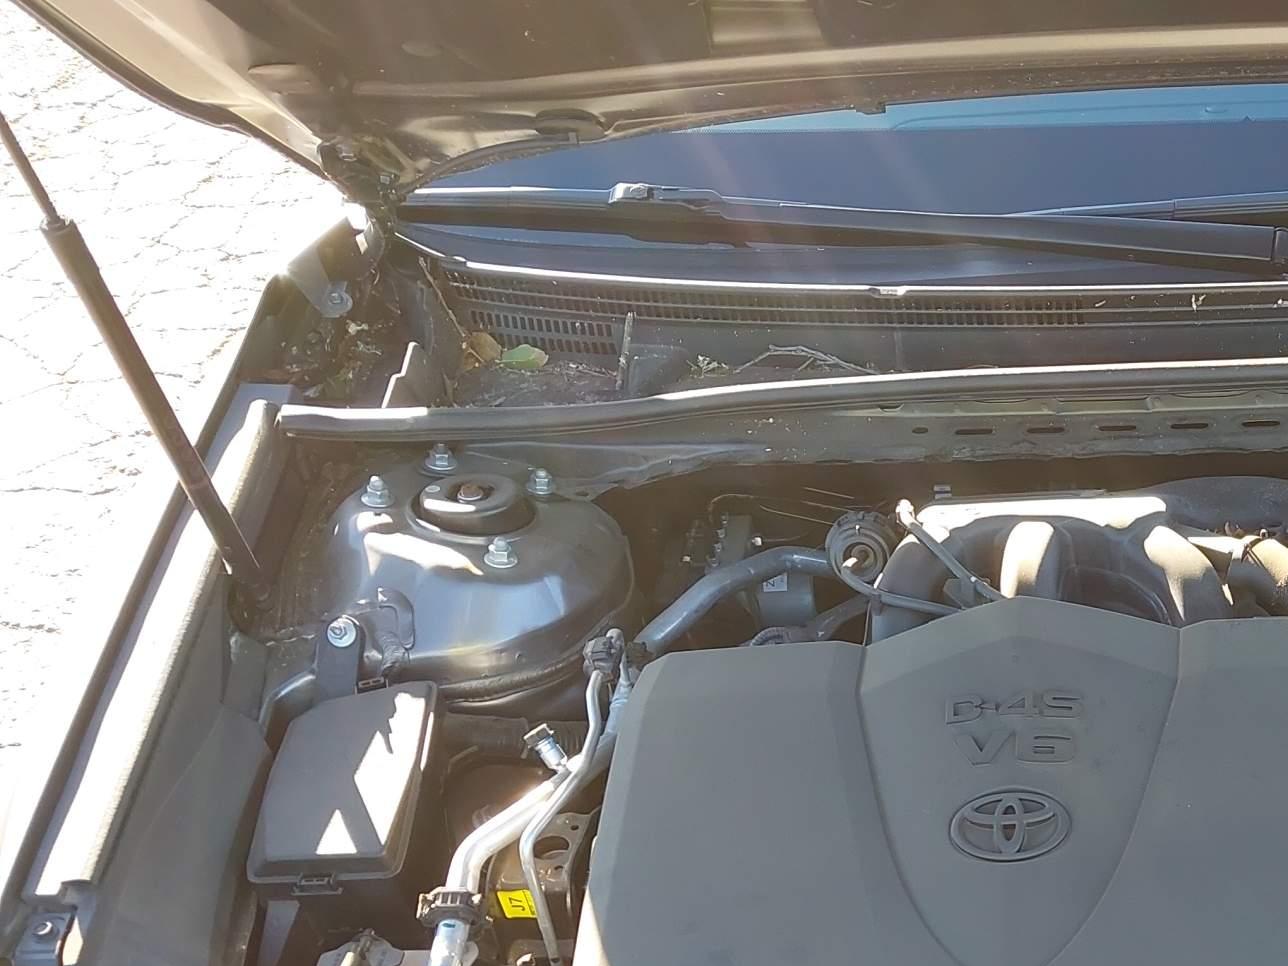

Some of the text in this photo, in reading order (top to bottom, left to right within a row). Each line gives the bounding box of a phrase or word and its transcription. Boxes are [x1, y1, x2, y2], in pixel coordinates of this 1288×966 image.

[945, 689, 1084, 725] D-4S
[953, 729, 1079, 766] V6
[508, 897, 526, 911] J7
